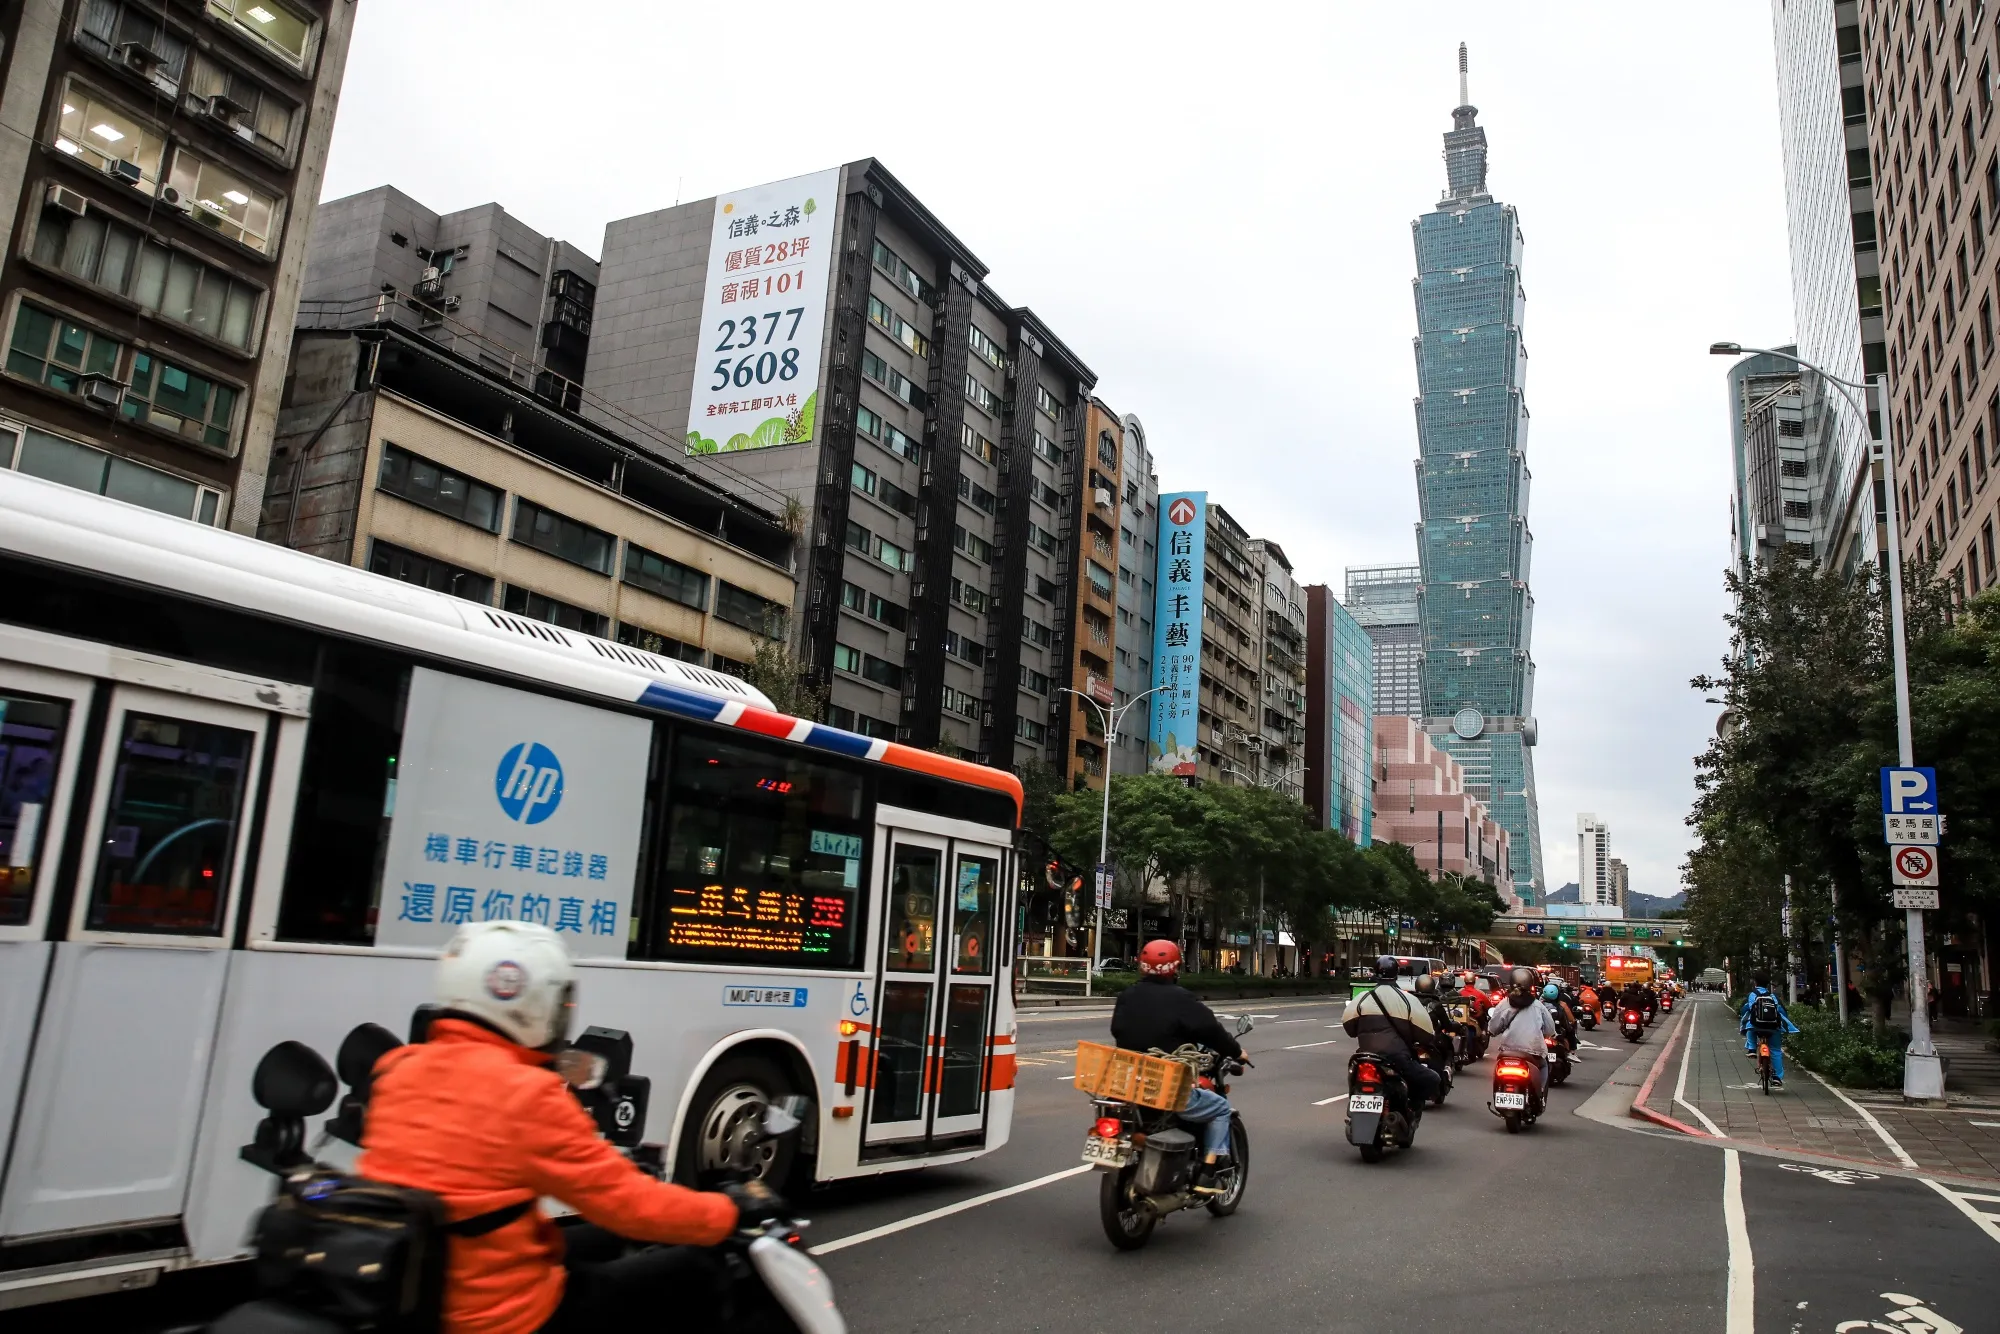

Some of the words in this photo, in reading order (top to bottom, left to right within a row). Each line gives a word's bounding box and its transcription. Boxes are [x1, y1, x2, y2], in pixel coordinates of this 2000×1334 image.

[724, 236, 810, 272] 優質28坪
[715, 307, 805, 352] 2377
[711, 347, 800, 391] 5608
[706, 393, 798, 416] 全新完工即可入住
[498, 742, 562, 824] hp
[1889, 770, 1928, 812] P
[1889, 818, 1933, 829] 愛馬屋
[424, 832, 609, 881] 機車行車記錄器
[398, 881, 618, 936] 還原你的真相
[730, 989, 763, 1003] MUFU
[1351, 1100, 1382, 1110] 726-CVP
